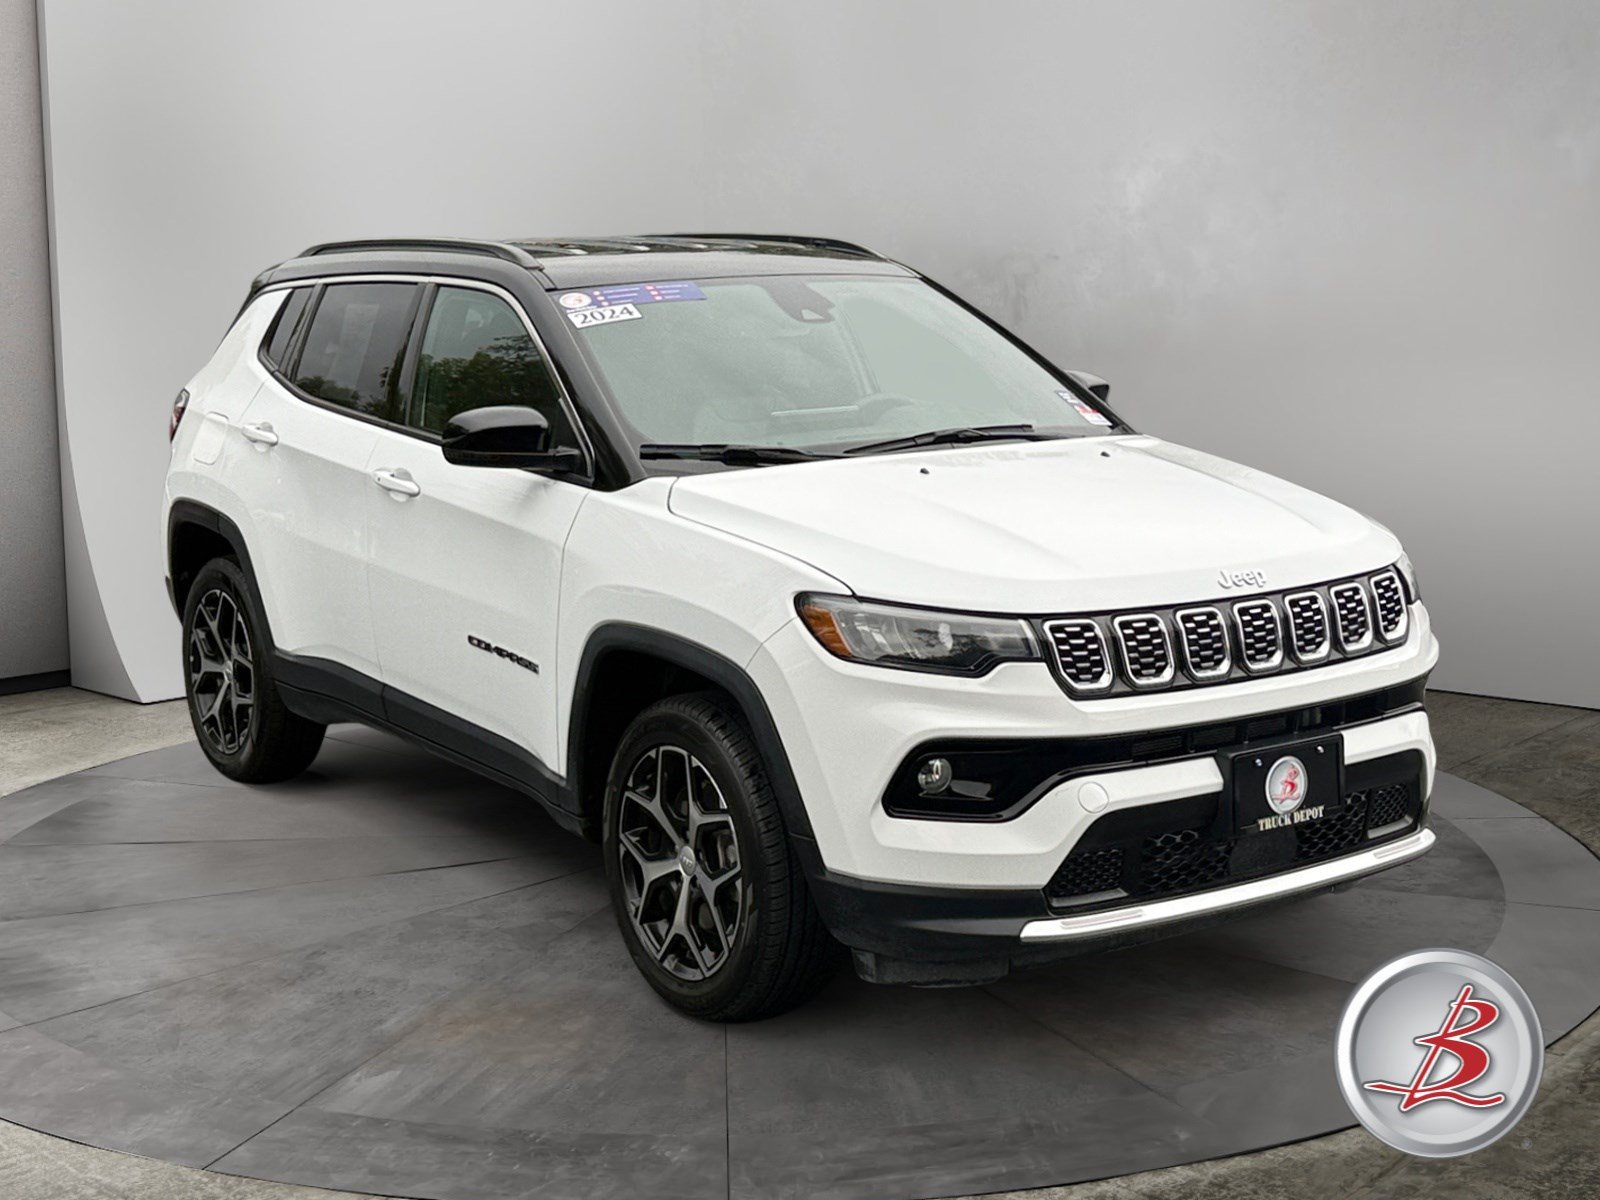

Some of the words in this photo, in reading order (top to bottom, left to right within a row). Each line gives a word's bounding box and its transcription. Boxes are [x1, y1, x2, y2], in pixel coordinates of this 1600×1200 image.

[574, 306, 634, 325] 2024
[1217, 568, 1267, 590] Jeep
[1258, 813, 1292, 831] TRUCK
[1293, 805, 1325, 824] DEPOT
